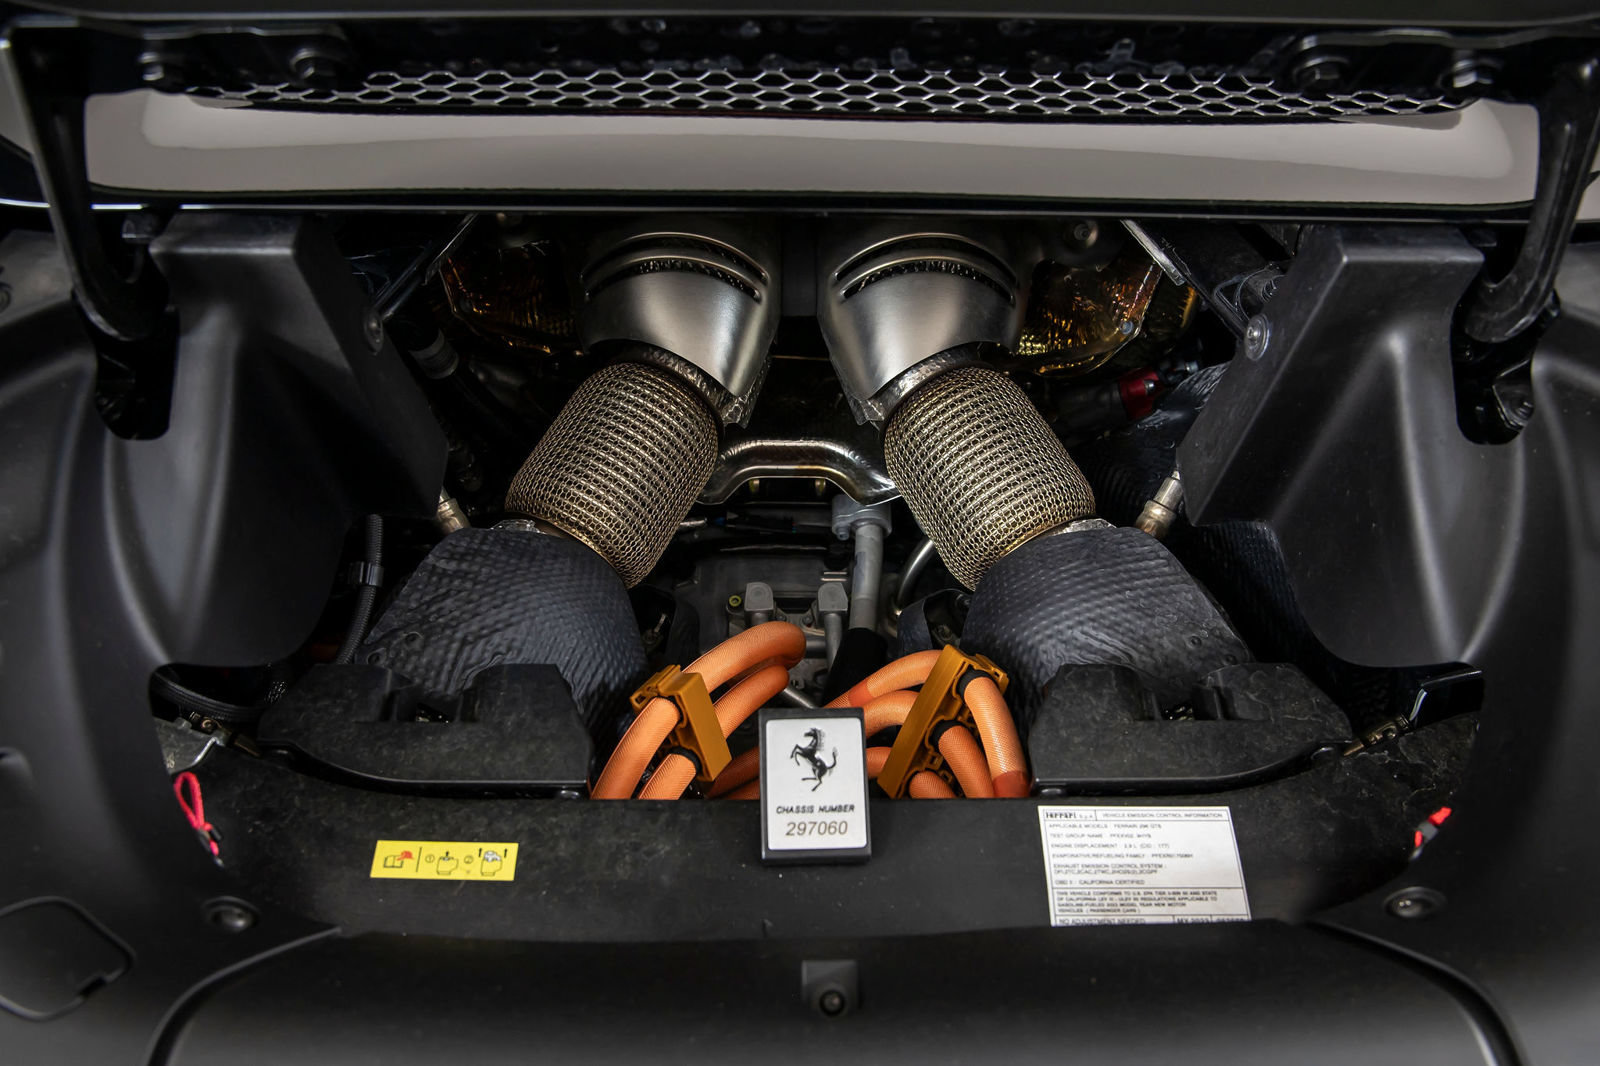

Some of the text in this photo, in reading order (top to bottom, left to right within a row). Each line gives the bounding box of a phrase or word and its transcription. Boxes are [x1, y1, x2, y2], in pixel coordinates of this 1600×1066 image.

[776, 804, 856, 815] CHASSIS NUMBER
[785, 820, 849, 837] 297060
